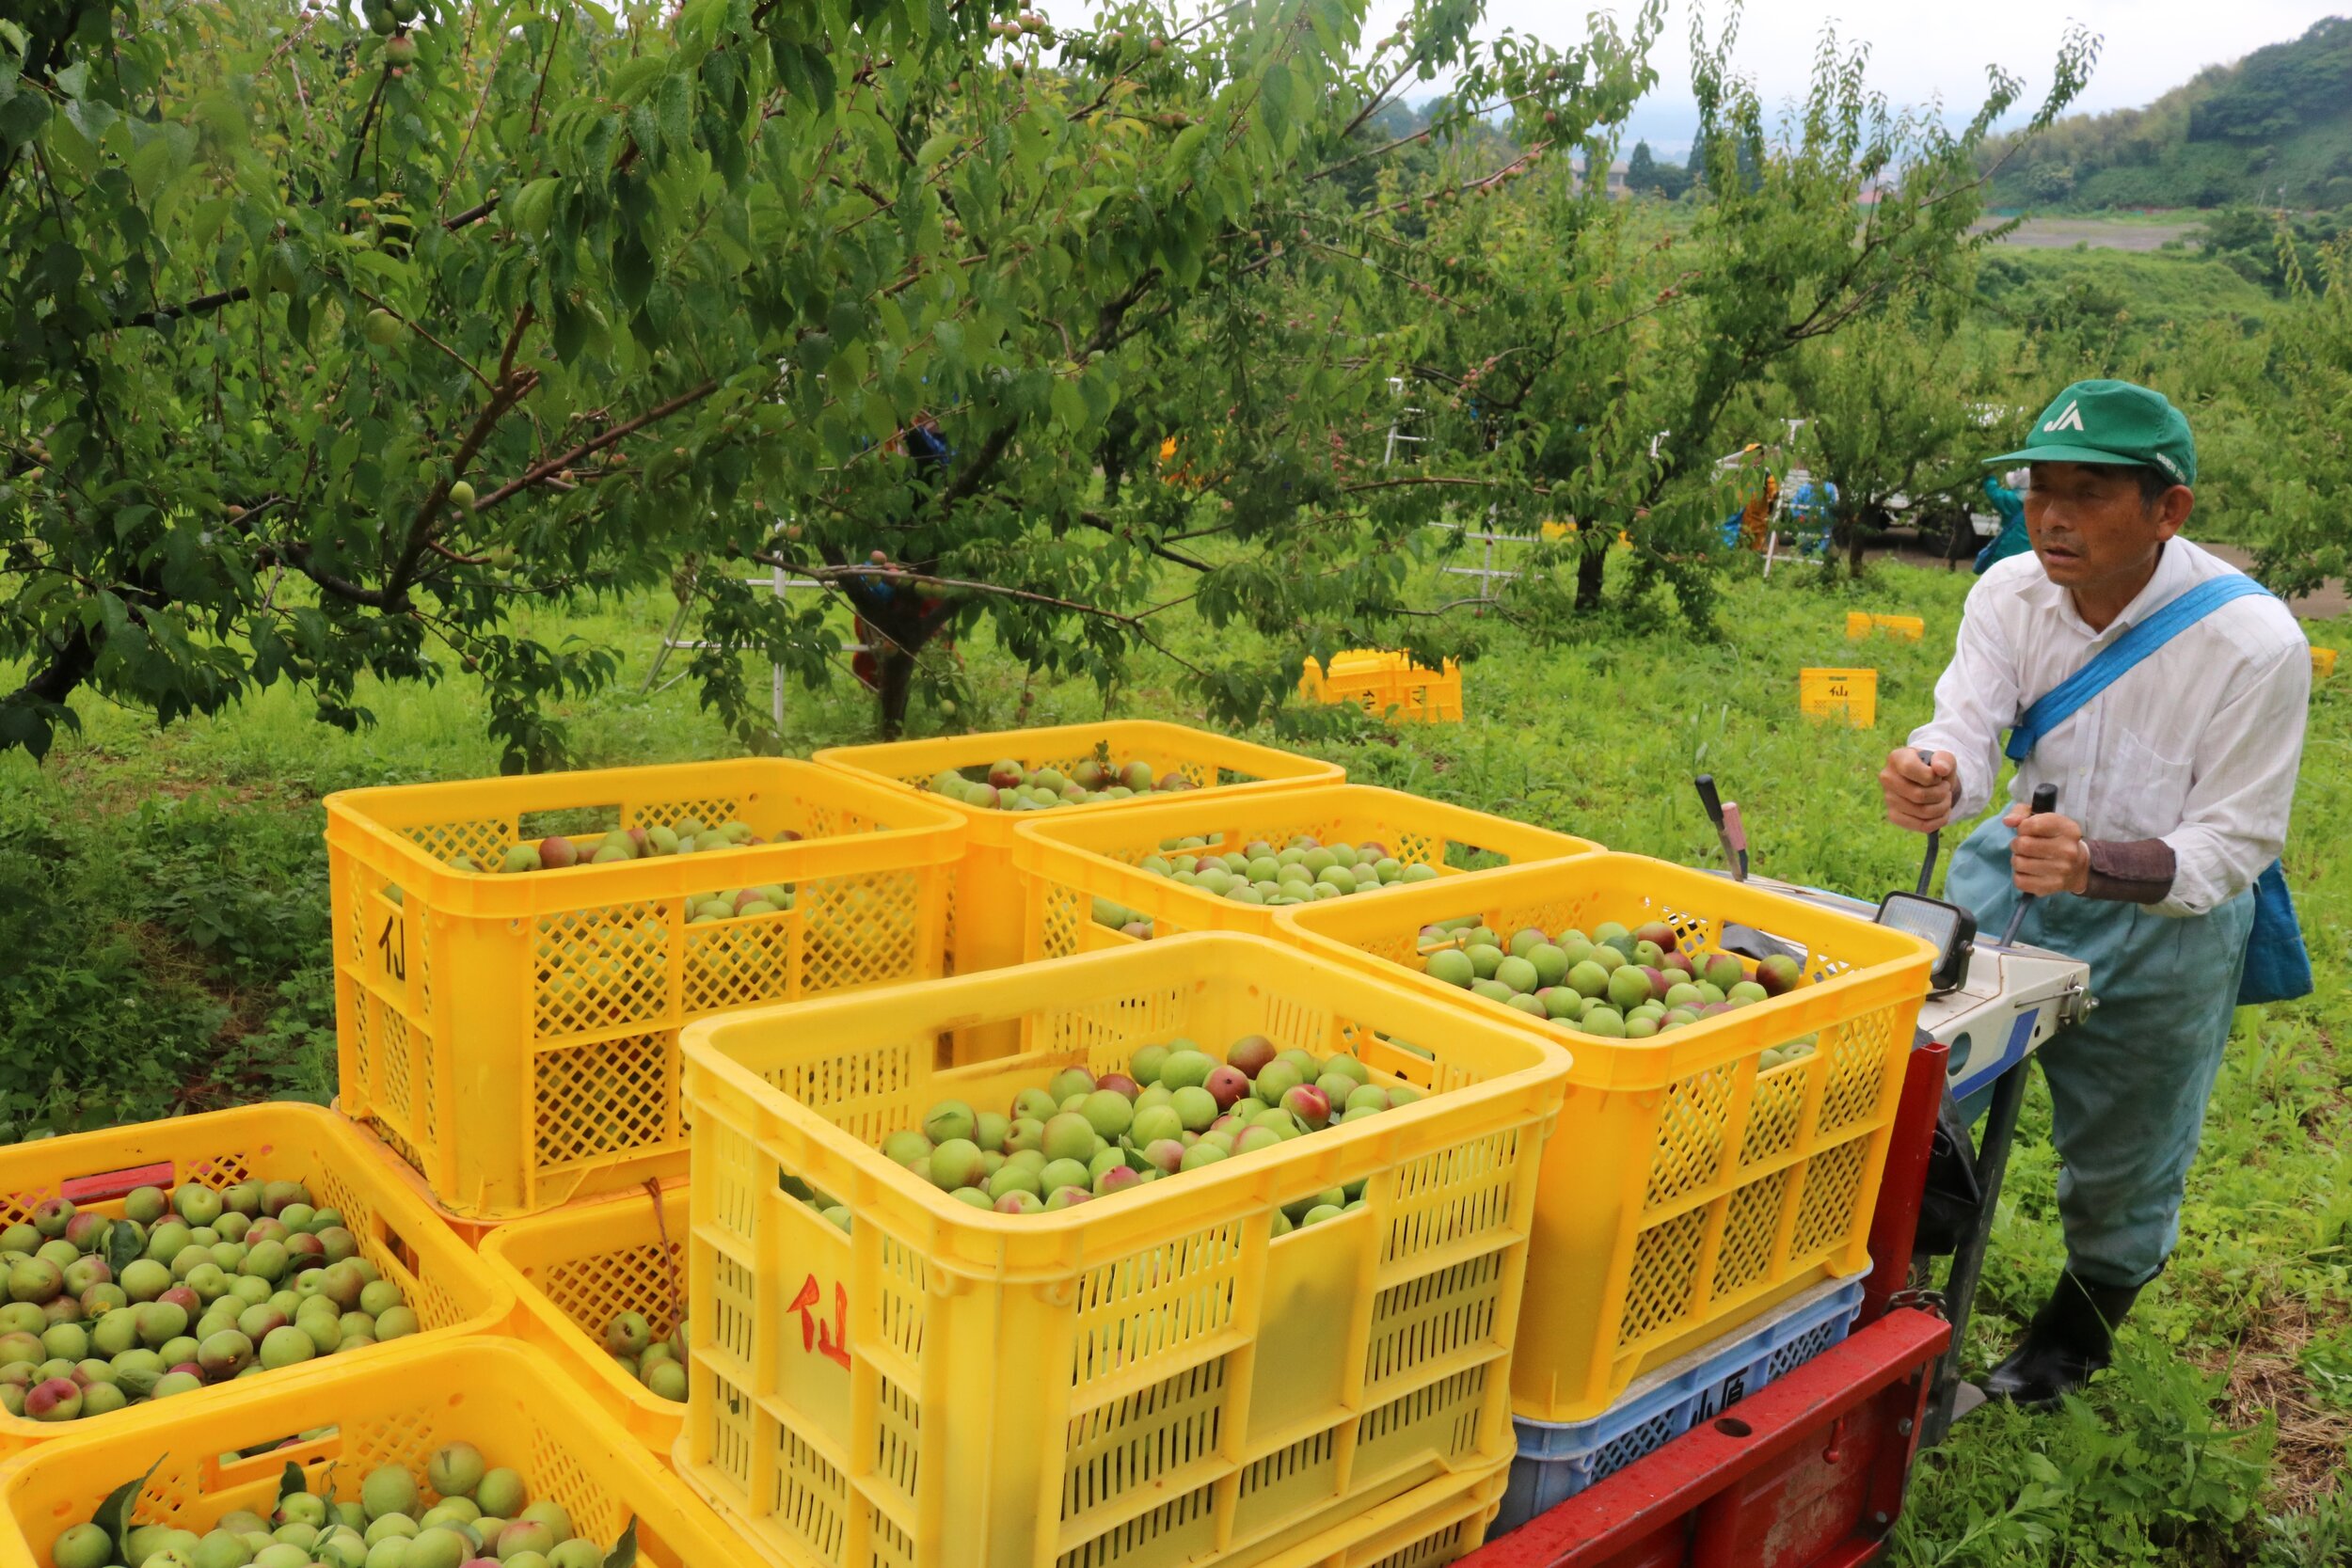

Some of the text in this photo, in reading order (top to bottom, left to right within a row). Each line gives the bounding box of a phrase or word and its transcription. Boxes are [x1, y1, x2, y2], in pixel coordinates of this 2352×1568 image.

[2043, 400, 2084, 432] JA
[1829, 685, 1849, 697] 仙
[786, 1273, 850, 1372] 仙
